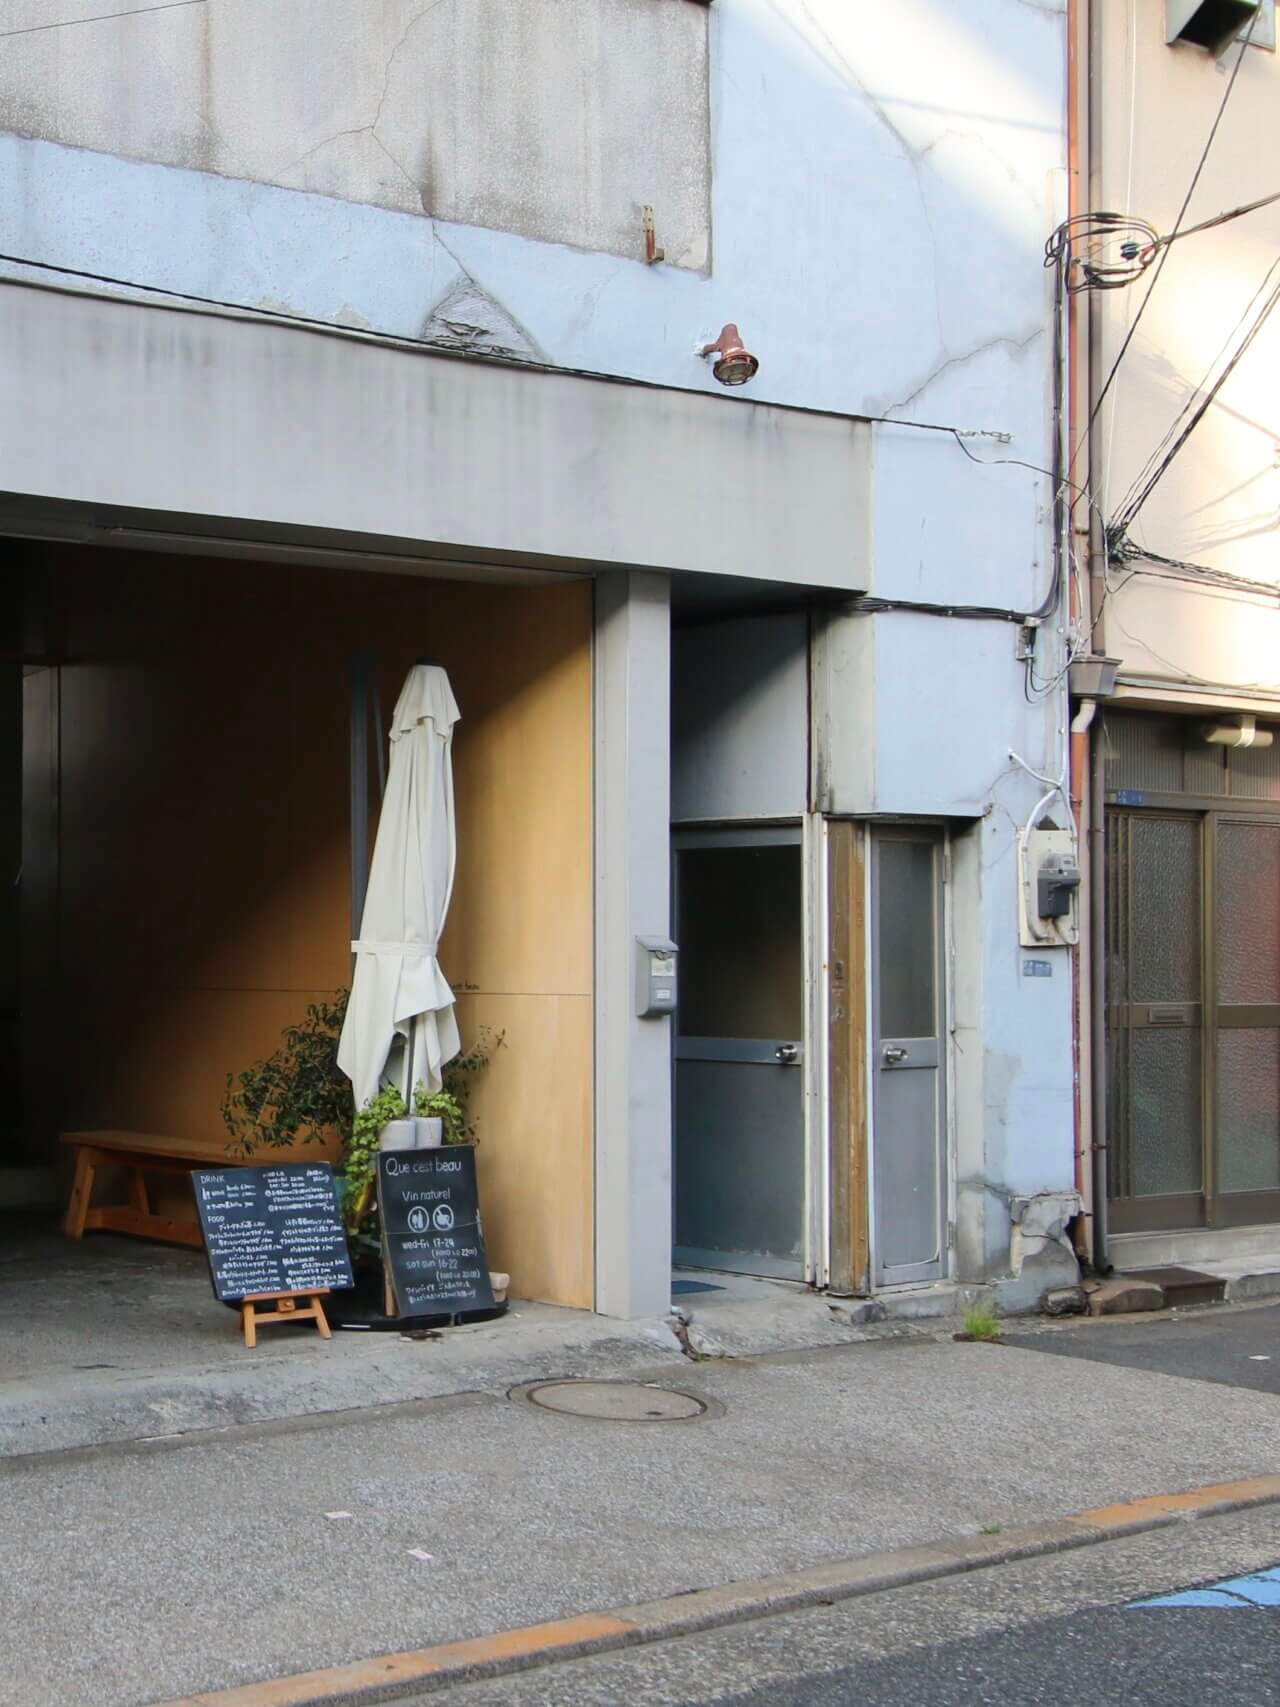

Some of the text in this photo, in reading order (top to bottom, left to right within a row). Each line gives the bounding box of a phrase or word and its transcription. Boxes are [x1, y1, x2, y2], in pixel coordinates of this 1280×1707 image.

[385, 1157, 410, 1177] Que
[435, 1155, 462, 1172] beau
[200, 1175, 225, 1184] DRINK
[402, 1186, 451, 1202] Vin naturel
